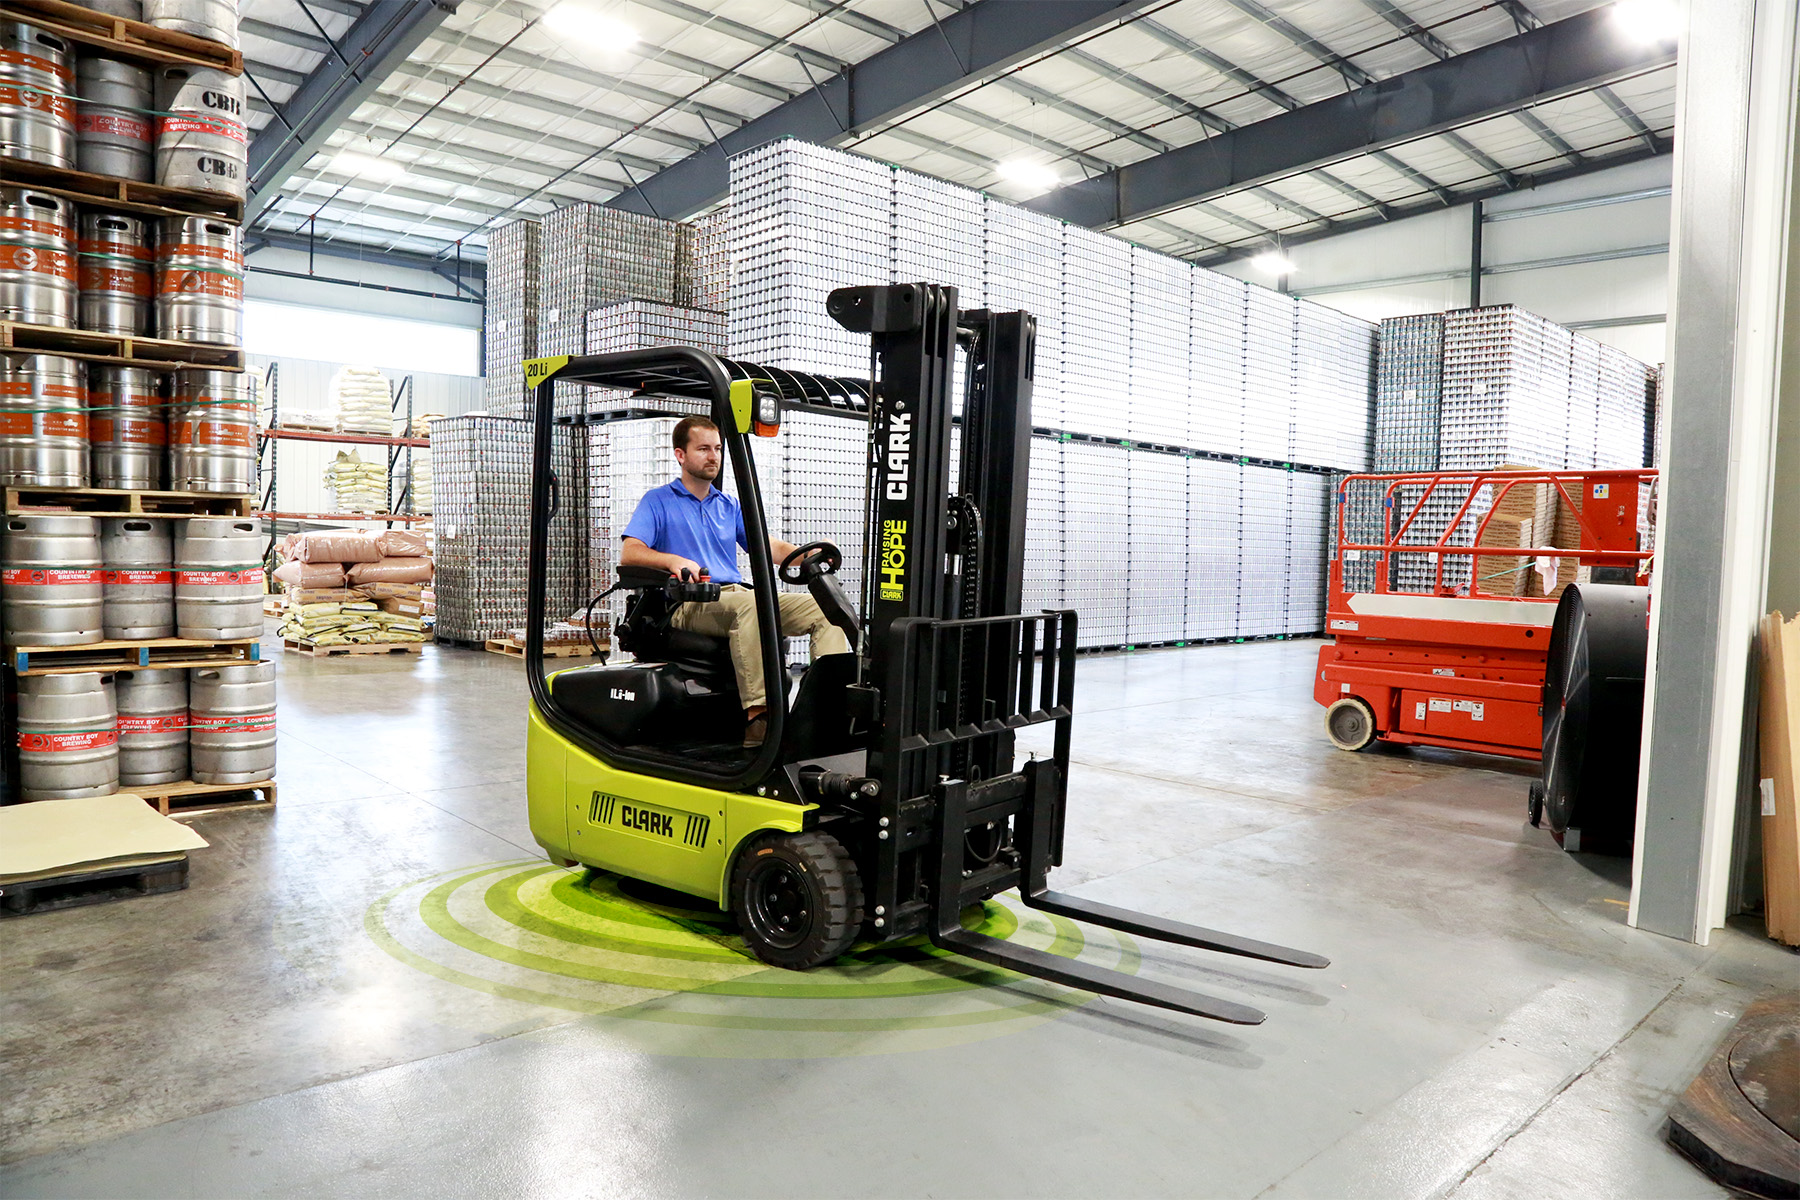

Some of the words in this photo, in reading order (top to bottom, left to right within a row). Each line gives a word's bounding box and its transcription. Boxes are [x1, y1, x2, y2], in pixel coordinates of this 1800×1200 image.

[527, 363, 538, 377] 20
[540, 362, 548, 375] Li
[886, 413, 911, 500] CLARK
[880, 519, 907, 590] HOPE
[882, 519, 892, 567] RAISING
[882, 590, 902, 599] CLARK
[622, 805, 673, 838] CLARK
